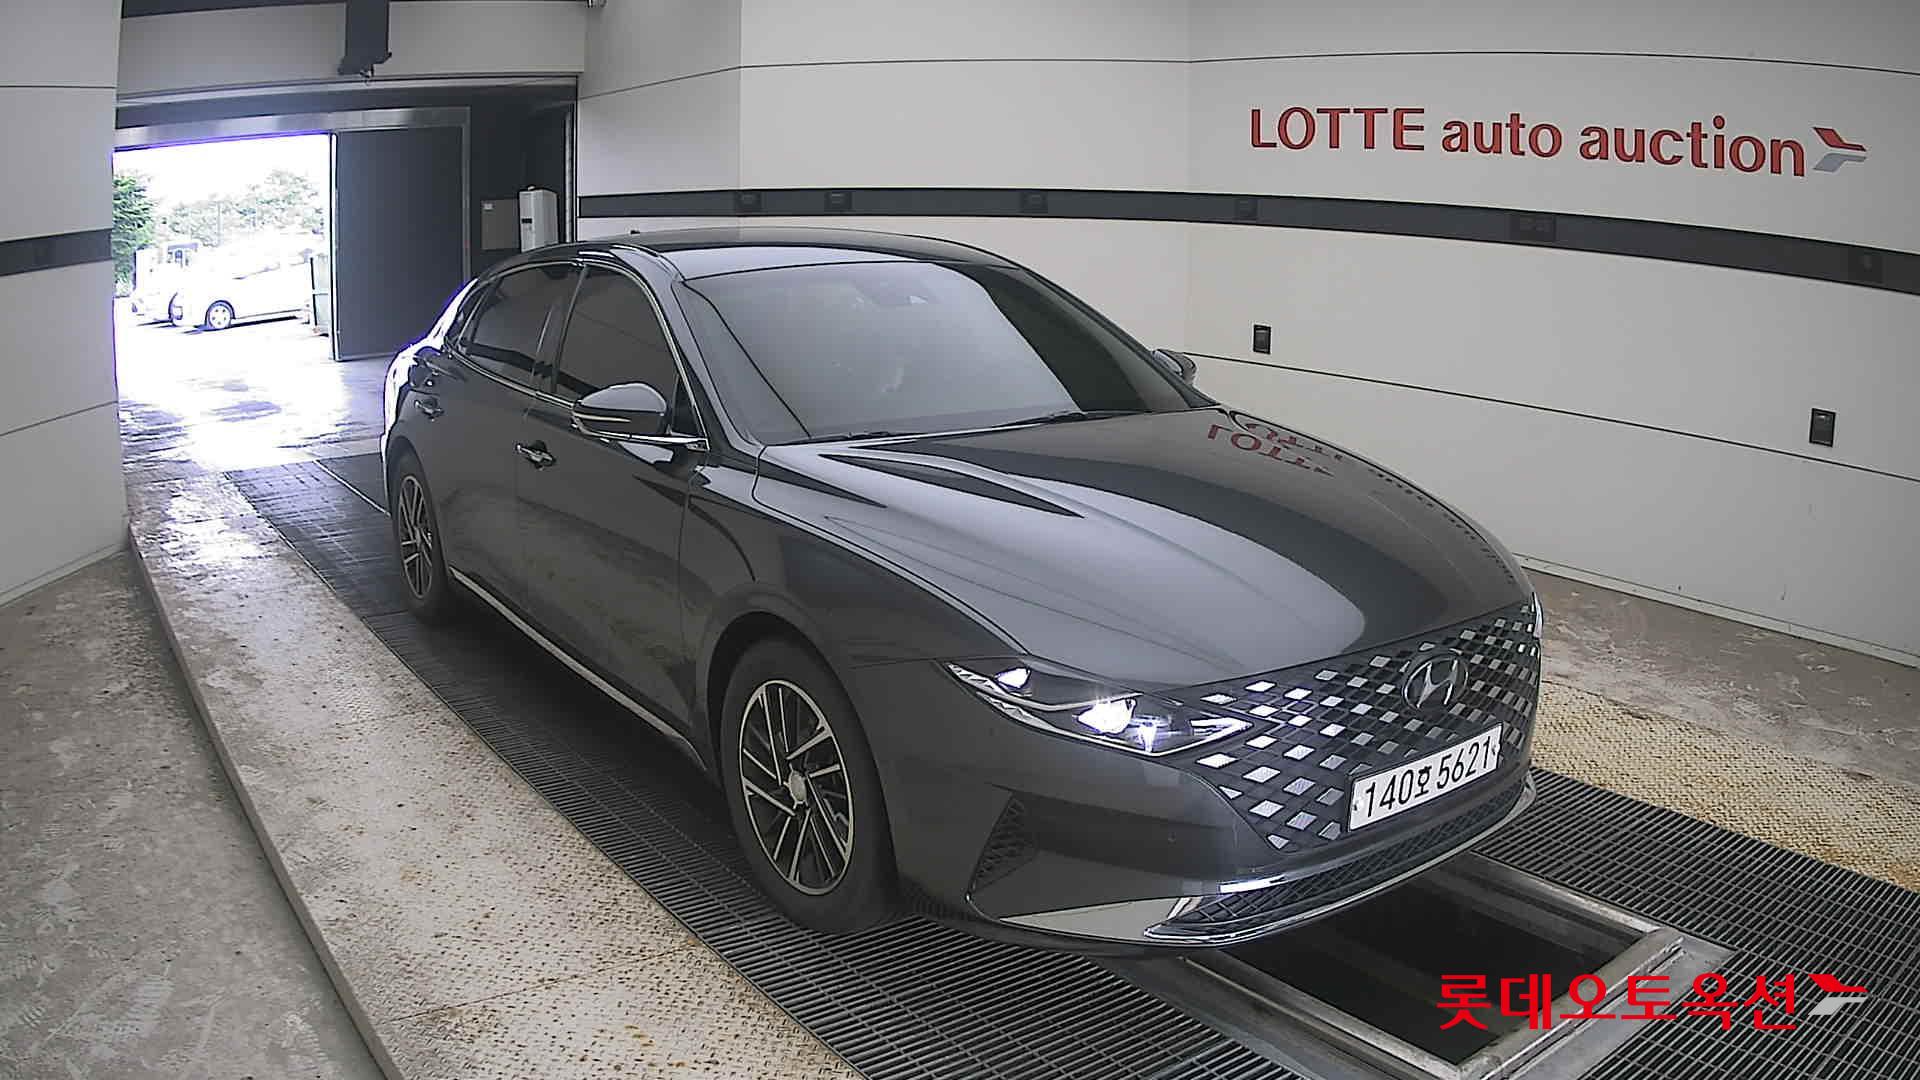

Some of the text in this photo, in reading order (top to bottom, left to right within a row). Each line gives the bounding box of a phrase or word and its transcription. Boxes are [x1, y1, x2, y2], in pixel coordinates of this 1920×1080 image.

[1250, 106, 1807, 178] LOTTE auto auction
[1364, 735, 1491, 818] 140호 5621
